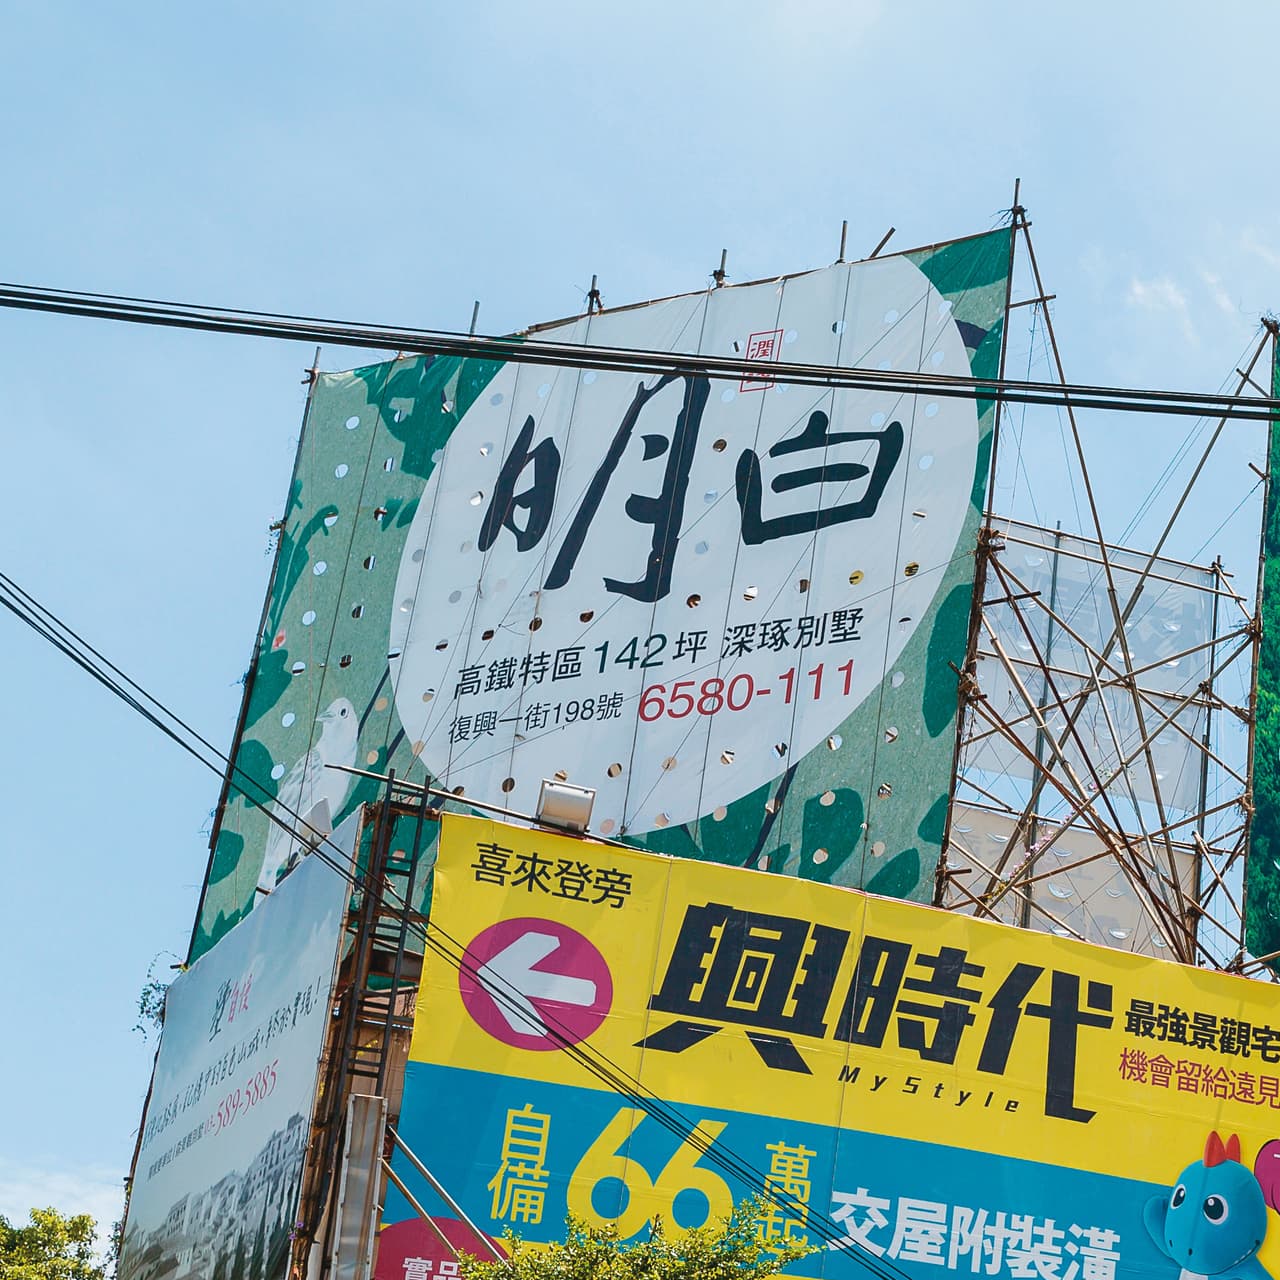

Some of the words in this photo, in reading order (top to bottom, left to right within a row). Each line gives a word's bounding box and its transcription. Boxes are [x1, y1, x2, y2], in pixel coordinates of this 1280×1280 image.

[477, 366, 905, 603] 明白
[447, 690, 623, 745] 復興一街198號
[638, 658, 857, 724] 6580-111
[471, 842, 633, 908] 喜來登旁
[632, 902, 1113, 1124] 興時代
[487, 1103, 552, 1226] 自備
[566, 1106, 734, 1243] 66
